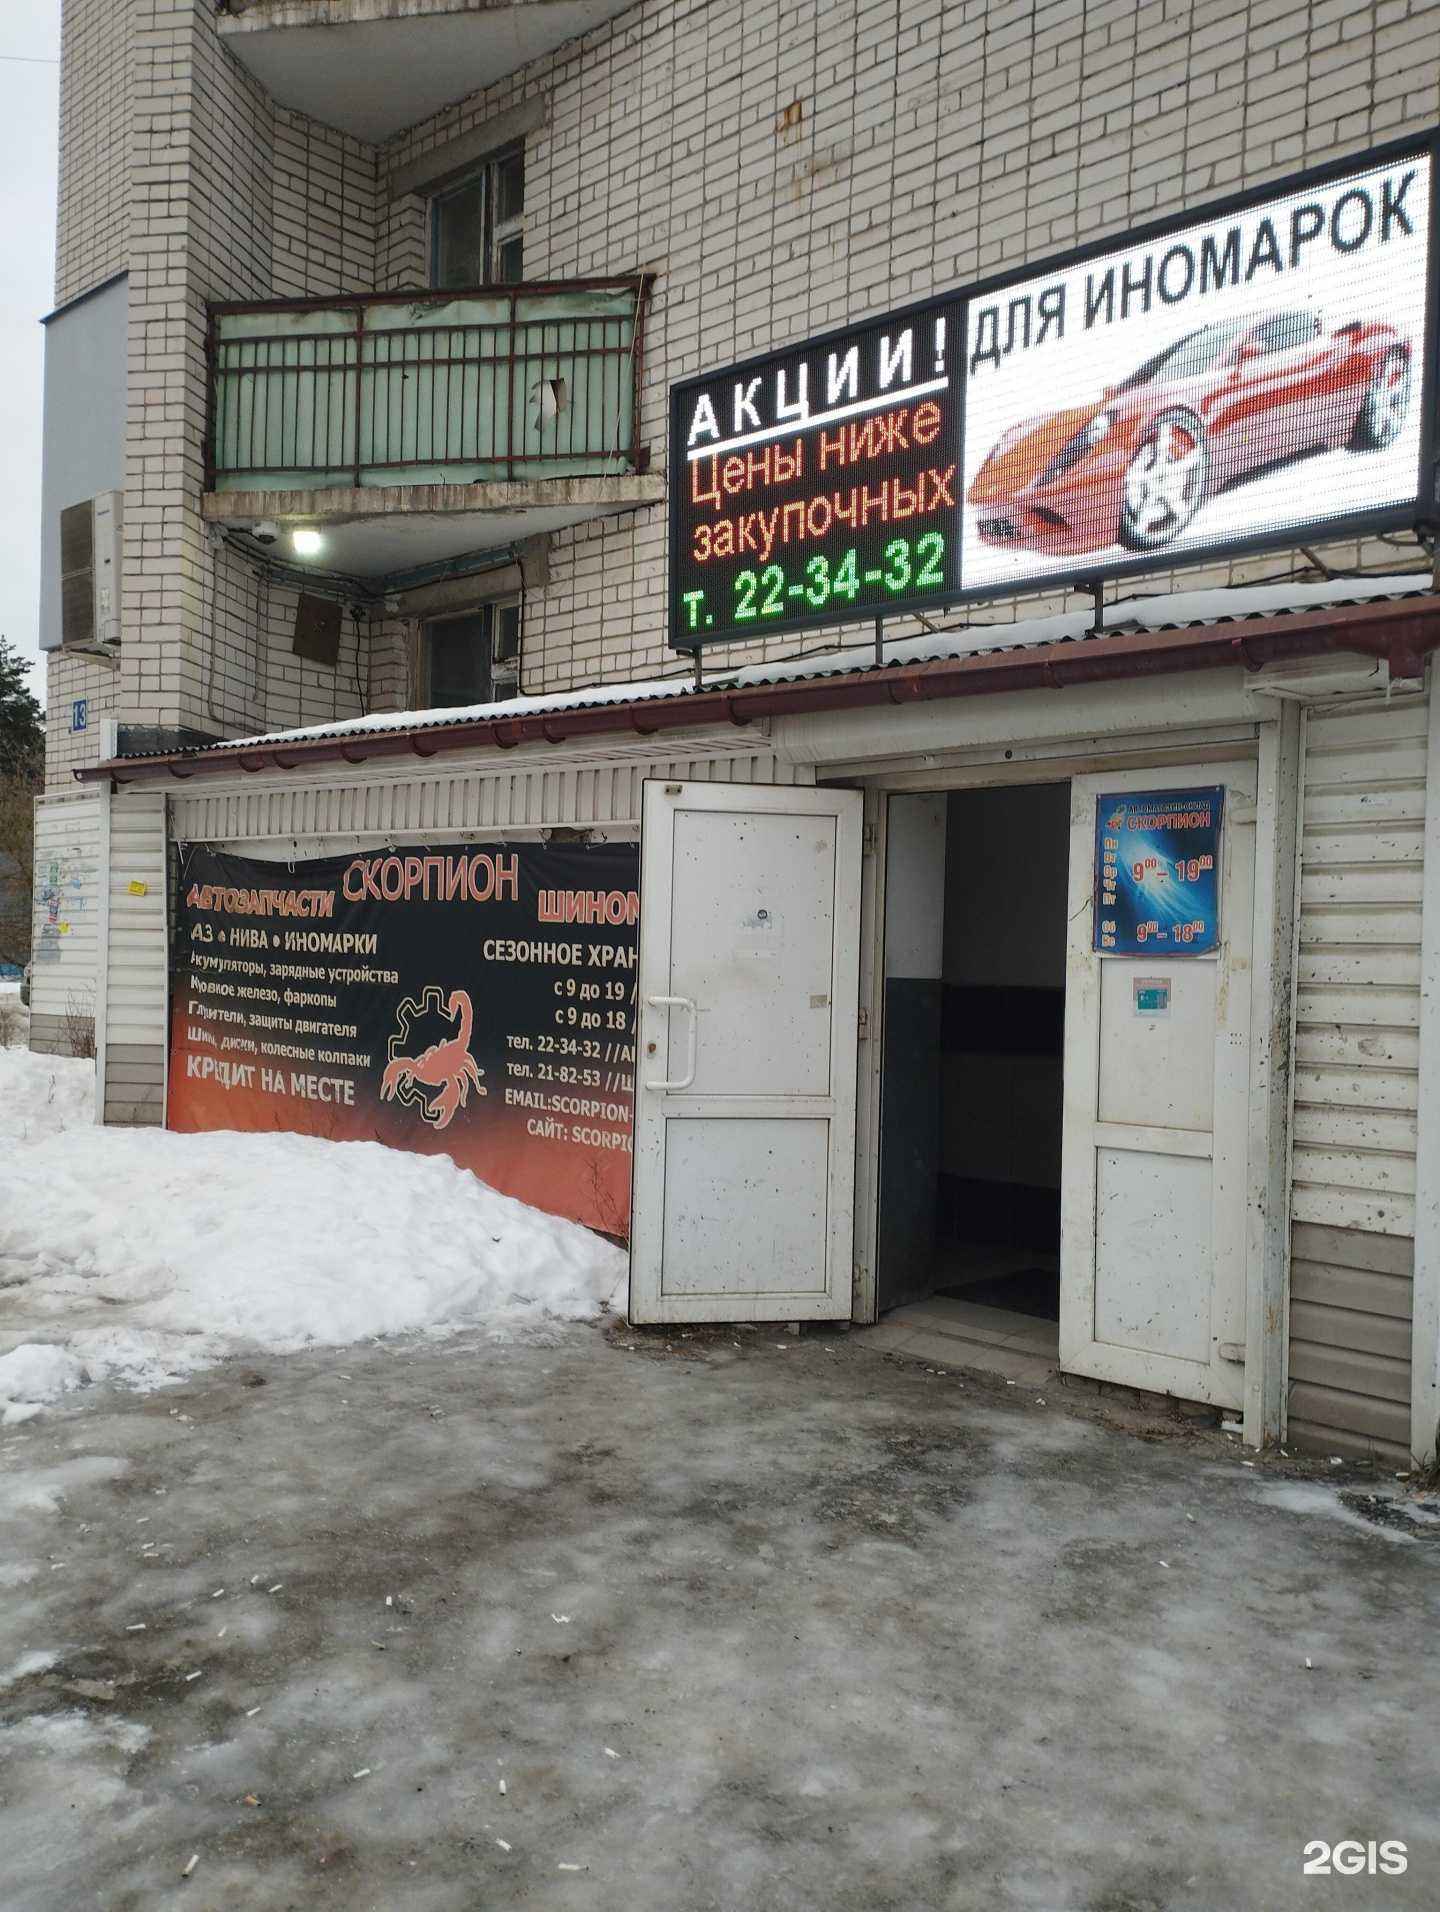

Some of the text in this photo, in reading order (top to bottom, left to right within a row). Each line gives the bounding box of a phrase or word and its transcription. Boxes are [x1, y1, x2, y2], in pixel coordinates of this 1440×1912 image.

[970, 169, 1417, 375] ДЛЯ ИНОМАРОК
[692, 401, 941, 510] Цены ниже
[693, 465, 956, 562] закупочных
[734, 531, 944, 619] 22-34-32
[74, 703, 86, 727] 13
[342, 854, 519, 902] СКОРПИОН
[186, 883, 335, 918] АВТОЗАПЧАСТИ
[230, 928, 268, 949] НИВА
[284, 931, 378, 955] ИНОМАРКИ
[483, 939, 583, 966] СЕЗОННОЕ
[270, 963, 326, 981] зарядные
[328, 965, 399, 985] устройства
[284, 987, 337, 1009] фаркопы
[554, 982, 563, 996] с
[566, 979, 576, 997] 9
[579, 983, 600, 1001] до
[605, 982, 625, 1001] 19
[249, 1014, 293, 1034] защиты
[295, 1019, 357, 1038] двигателя
[555, 1009, 564, 1024] с
[567, 1007, 577, 1026] 9
[581, 1012, 601, 1029] до
[606, 1011, 626, 1030] 18
[261, 1041, 315, 1061] колесные
[318, 1049, 371, 1068] колпаки
[506, 1035, 533, 1052] тел.
[537, 1035, 601, 1058] 22-34-32
[261, 1068, 286, 1095] НА
[290, 1072, 355, 1106] МЕСТЕ
[506, 1062, 533, 1078] тел.
[537, 1063, 601, 1087] 21-82-53
[526, 1116, 568, 1141] САЙТ:
